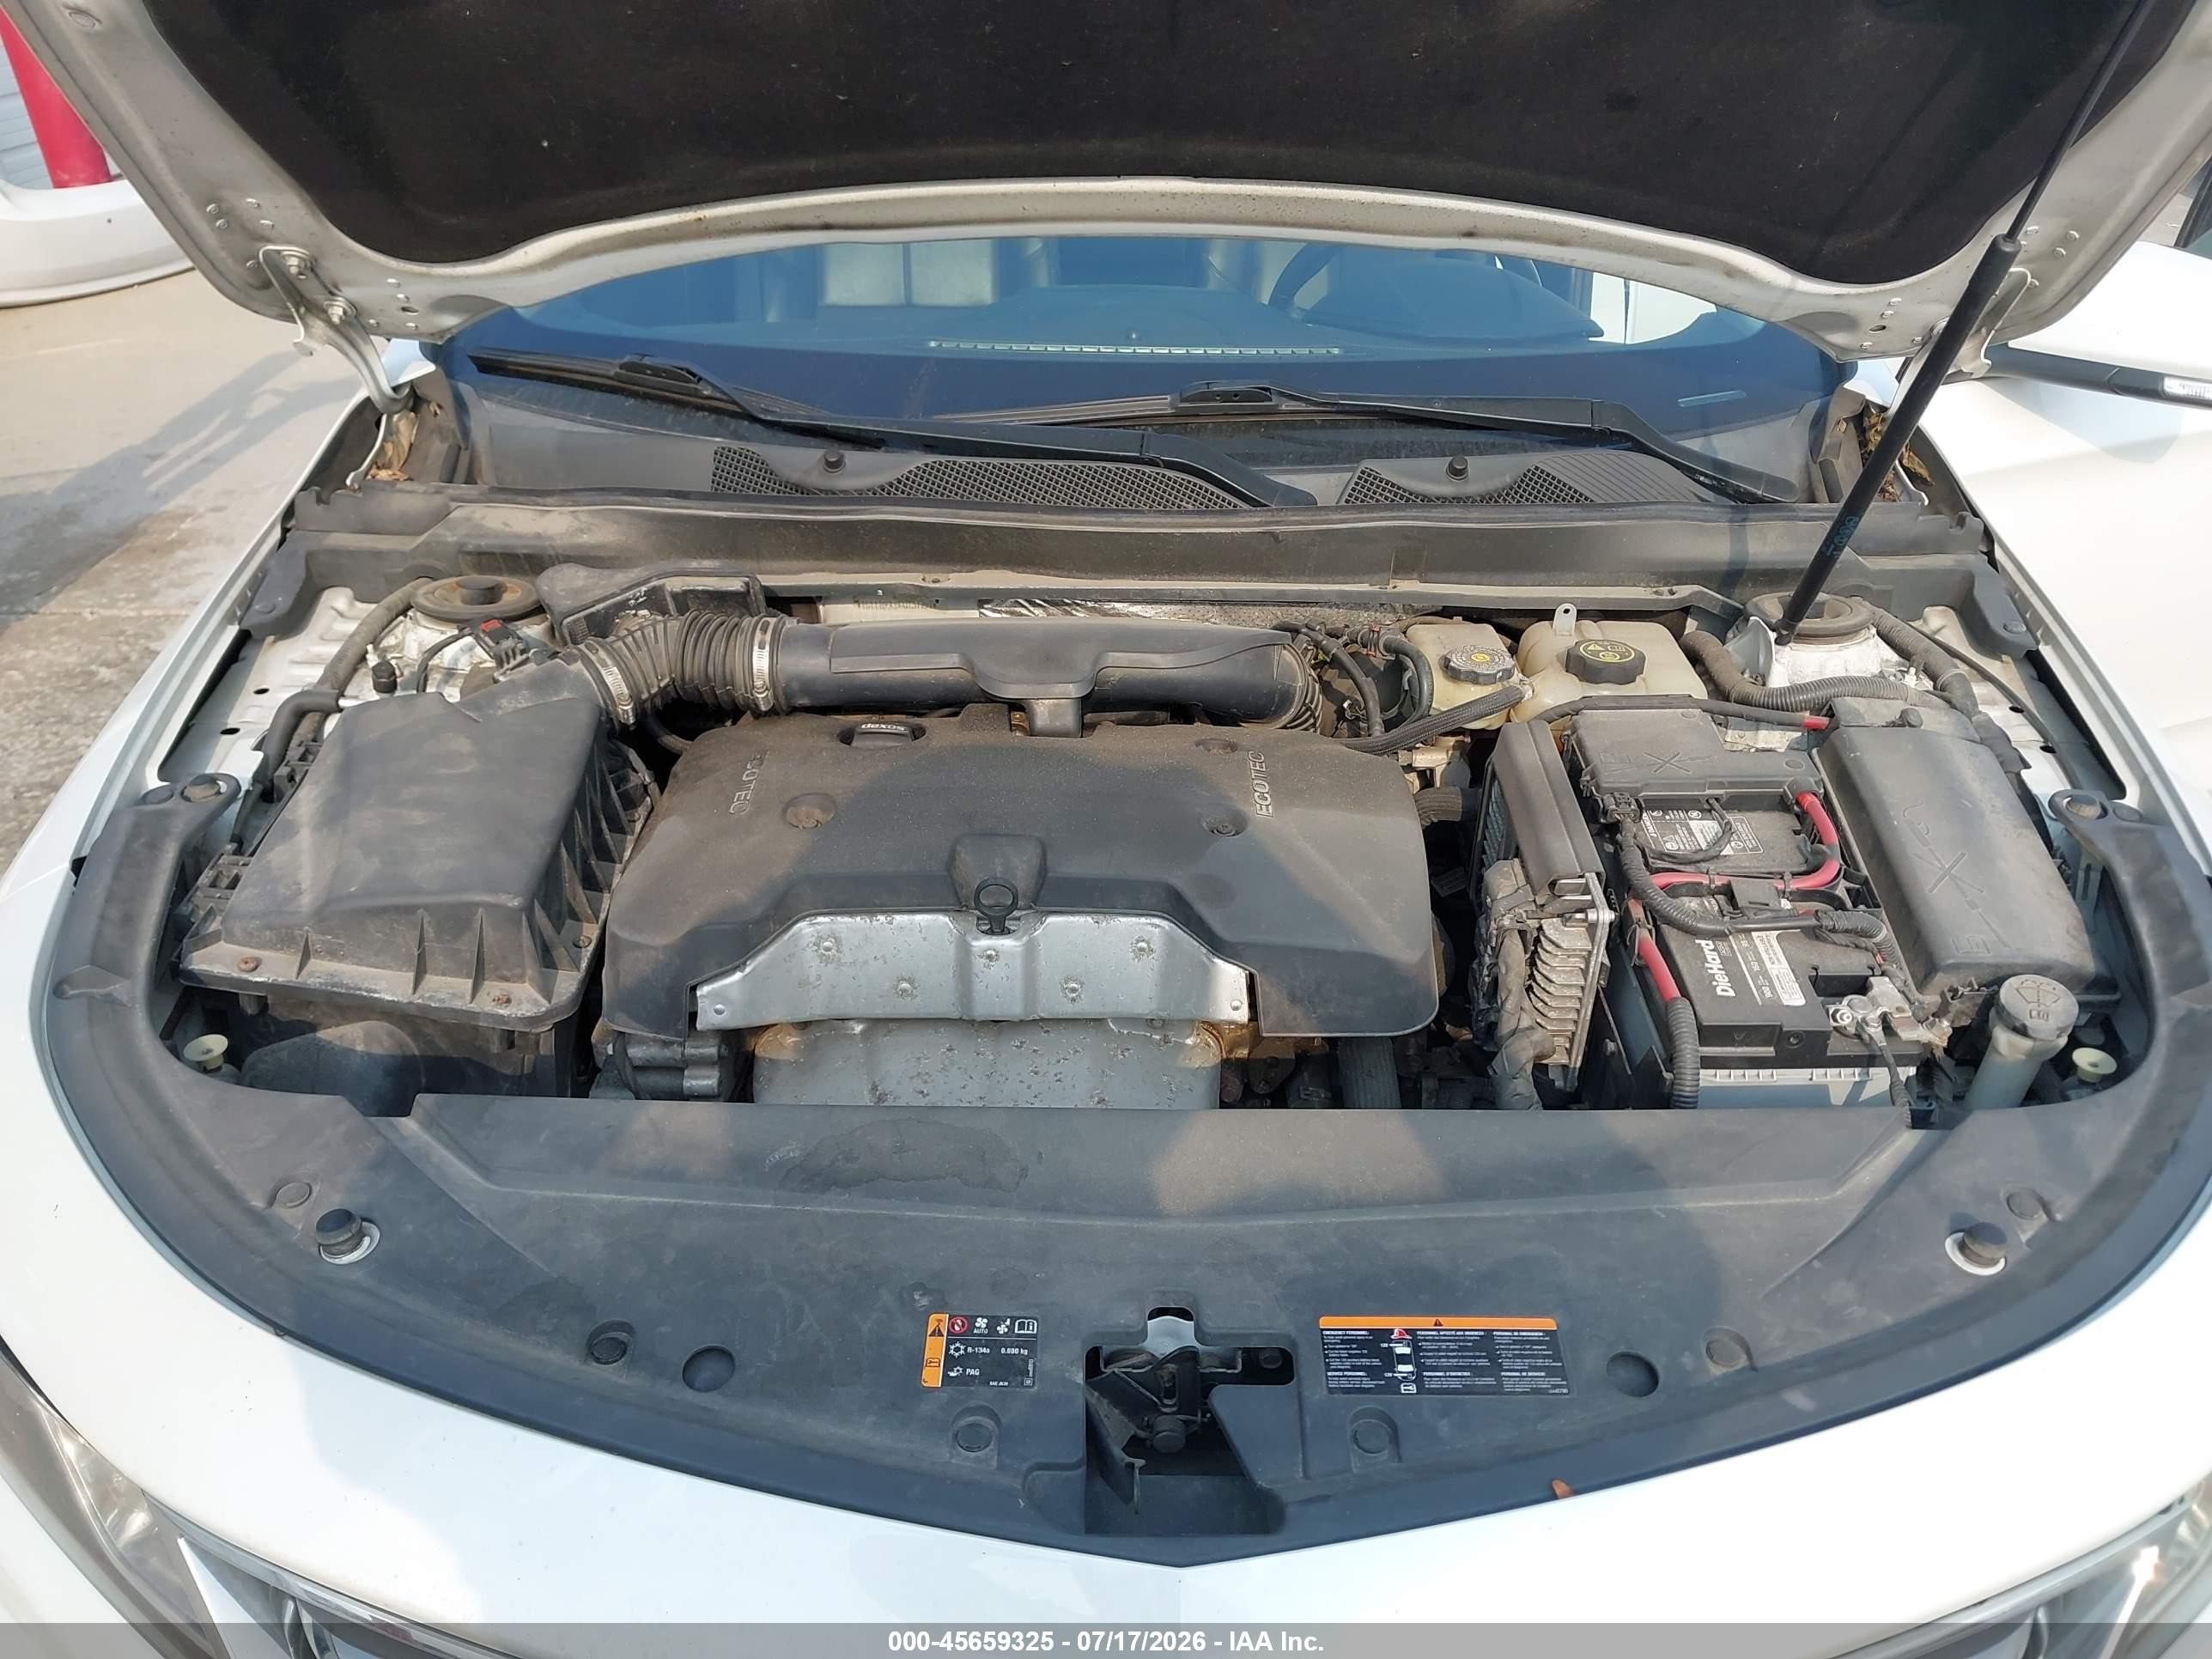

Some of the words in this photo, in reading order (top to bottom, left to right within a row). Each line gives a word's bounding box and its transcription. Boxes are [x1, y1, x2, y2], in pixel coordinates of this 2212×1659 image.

[860, 722, 908, 732] dexos
[1248, 750, 1273, 817] ECOTEC
[1694, 938, 1736, 997] DieHard
